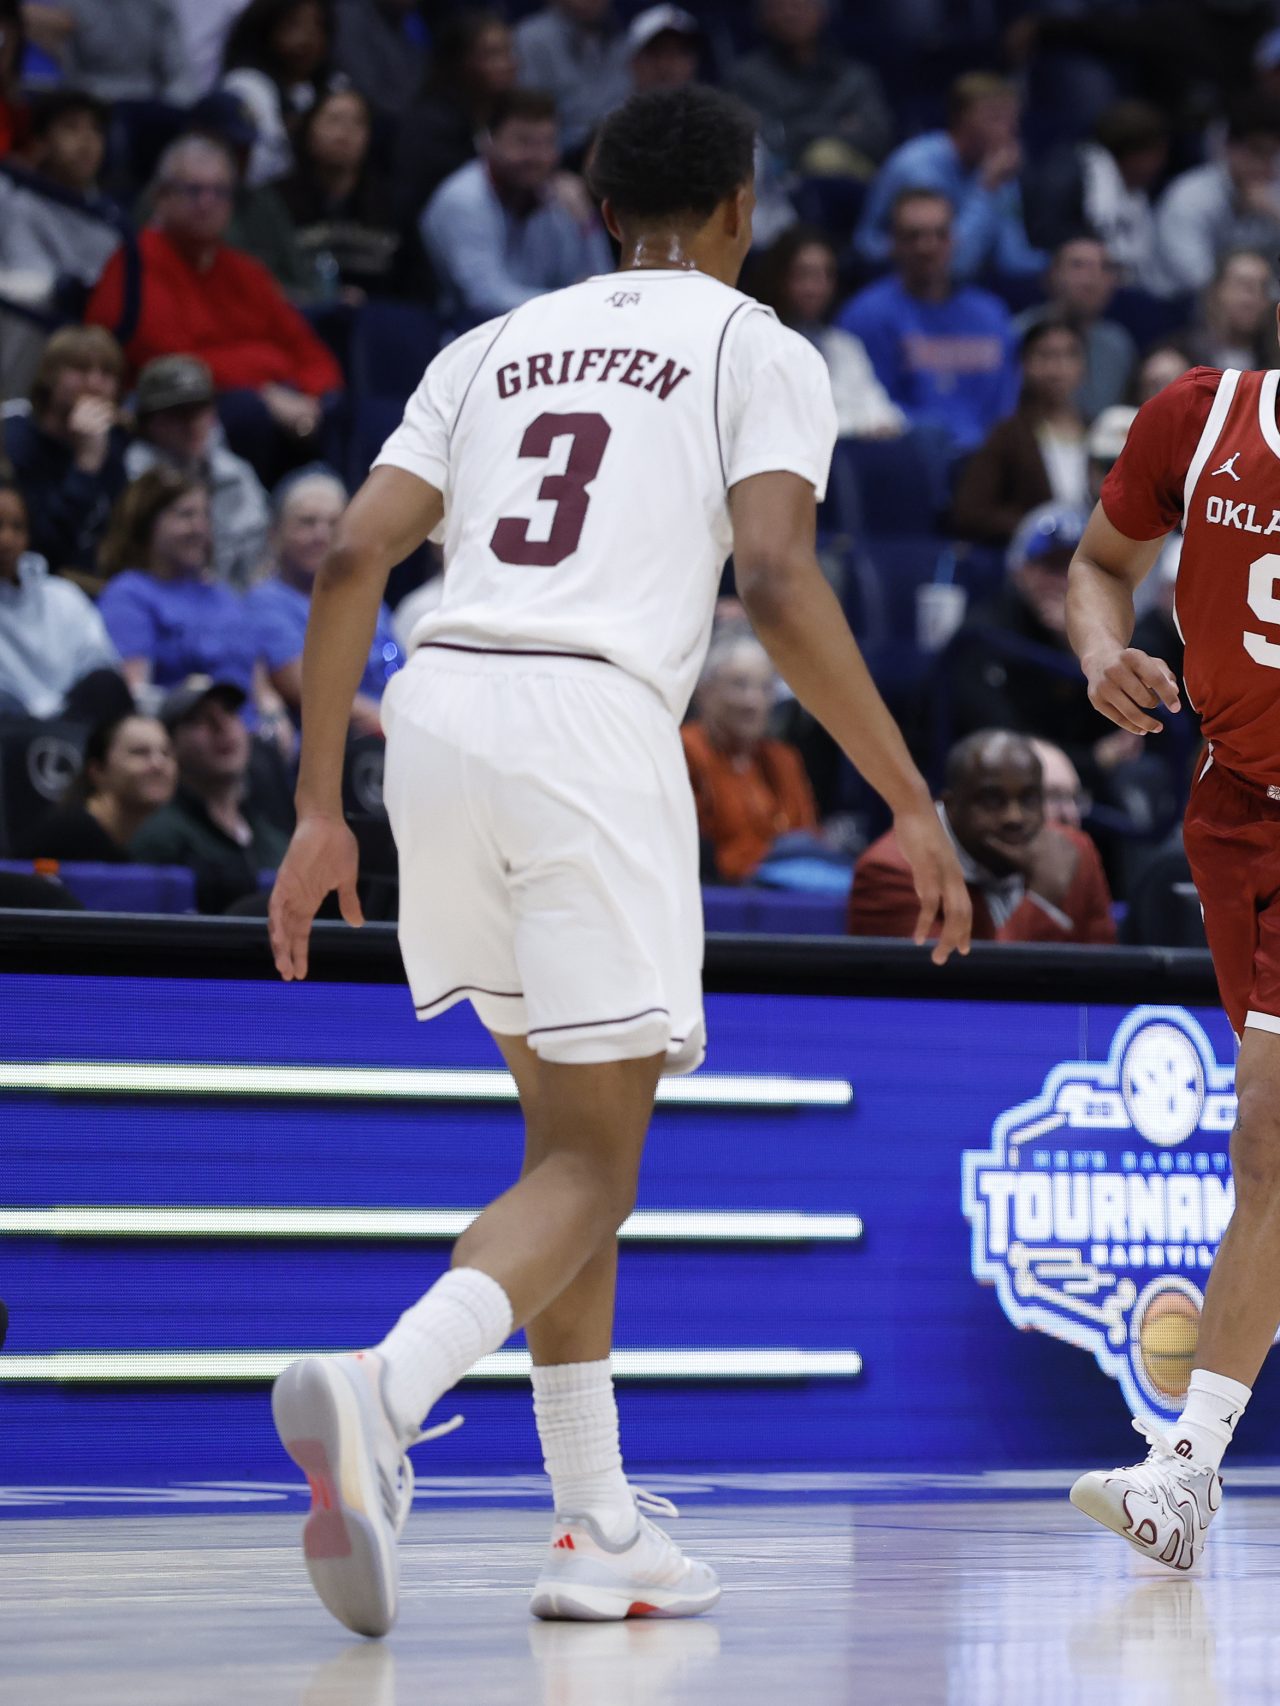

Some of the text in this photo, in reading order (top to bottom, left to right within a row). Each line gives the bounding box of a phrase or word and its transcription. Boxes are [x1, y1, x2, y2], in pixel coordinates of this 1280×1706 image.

[496, 349, 691, 401] GRIFFEN
[489, 412, 612, 567] 3
[1091, 1244, 1220, 1267] NASHVIL
